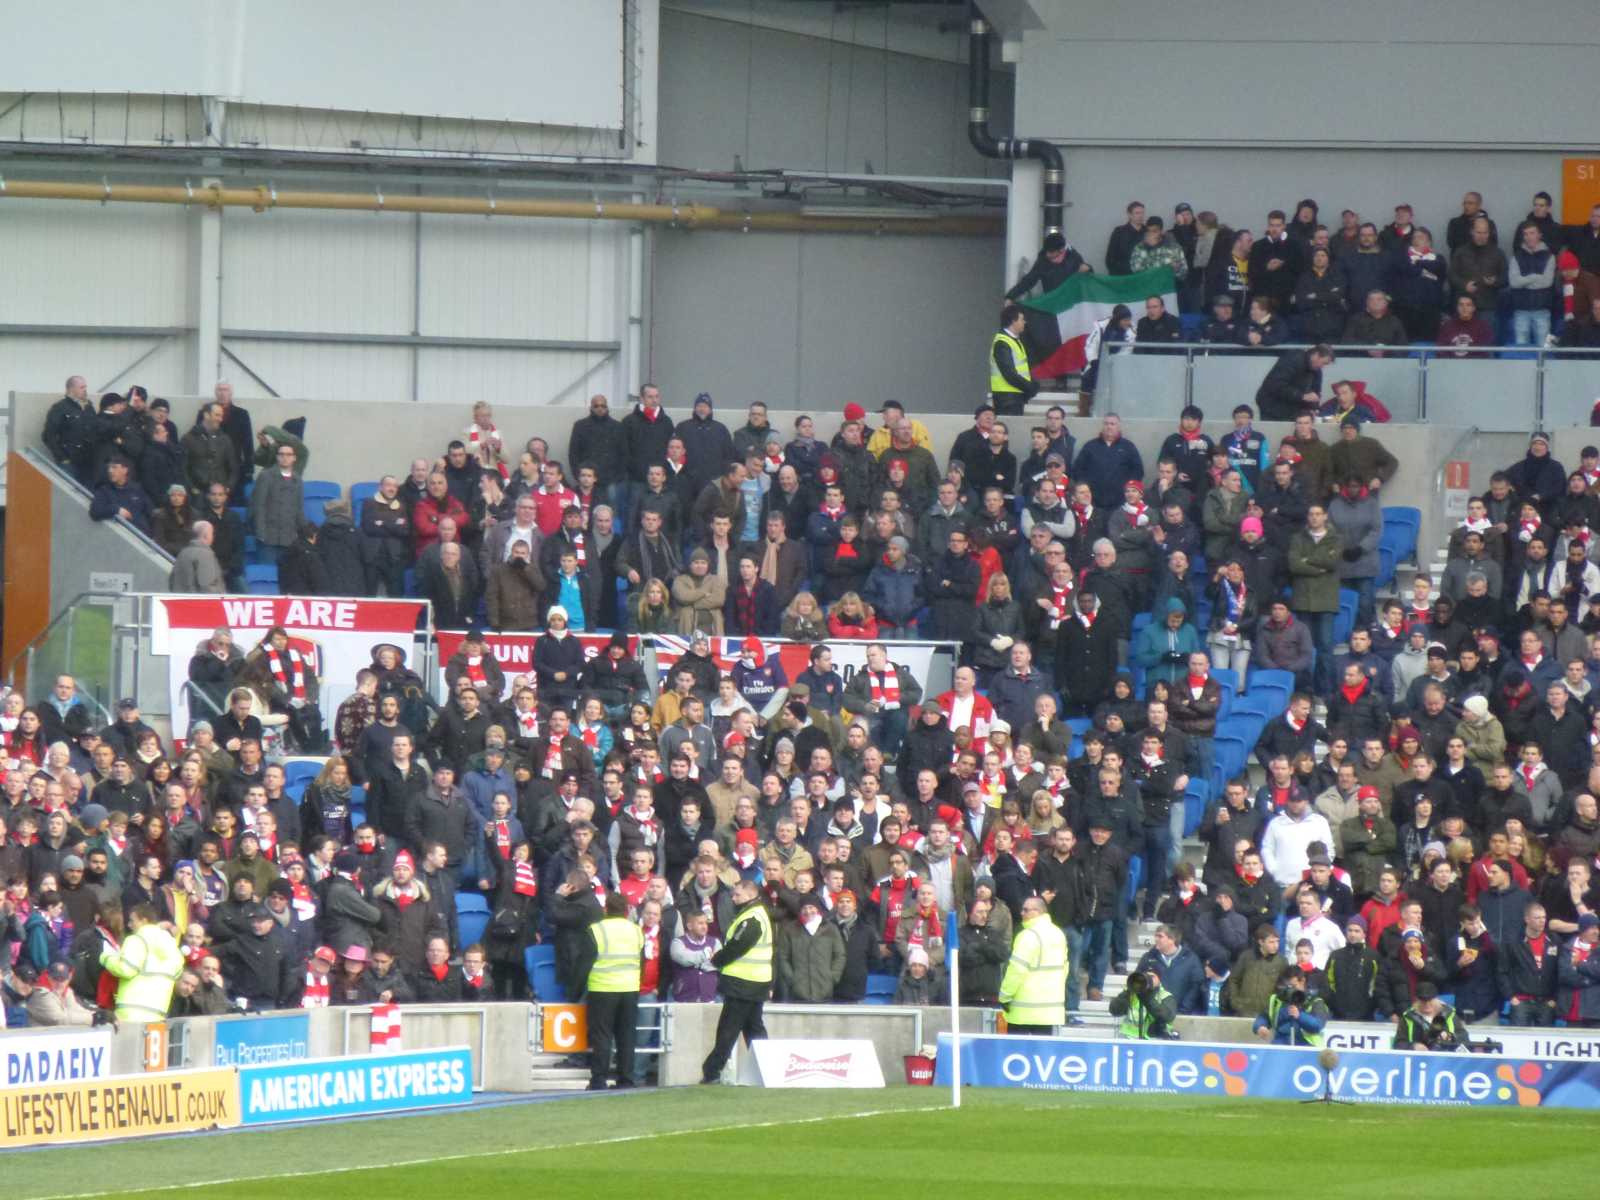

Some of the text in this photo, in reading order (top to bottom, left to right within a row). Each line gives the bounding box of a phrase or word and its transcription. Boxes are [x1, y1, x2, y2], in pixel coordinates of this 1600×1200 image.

[222, 599, 358, 629] WE ARE
[149, 1030, 161, 1068] B
[553, 1011, 577, 1048] C
[249, 1058, 465, 1114] AMERICAN EXPRESS
[1002, 1045, 1199, 1089] overline
[1292, 1057, 1492, 1100] overline
[5, 1089, 99, 1137] LIFESTYLE
